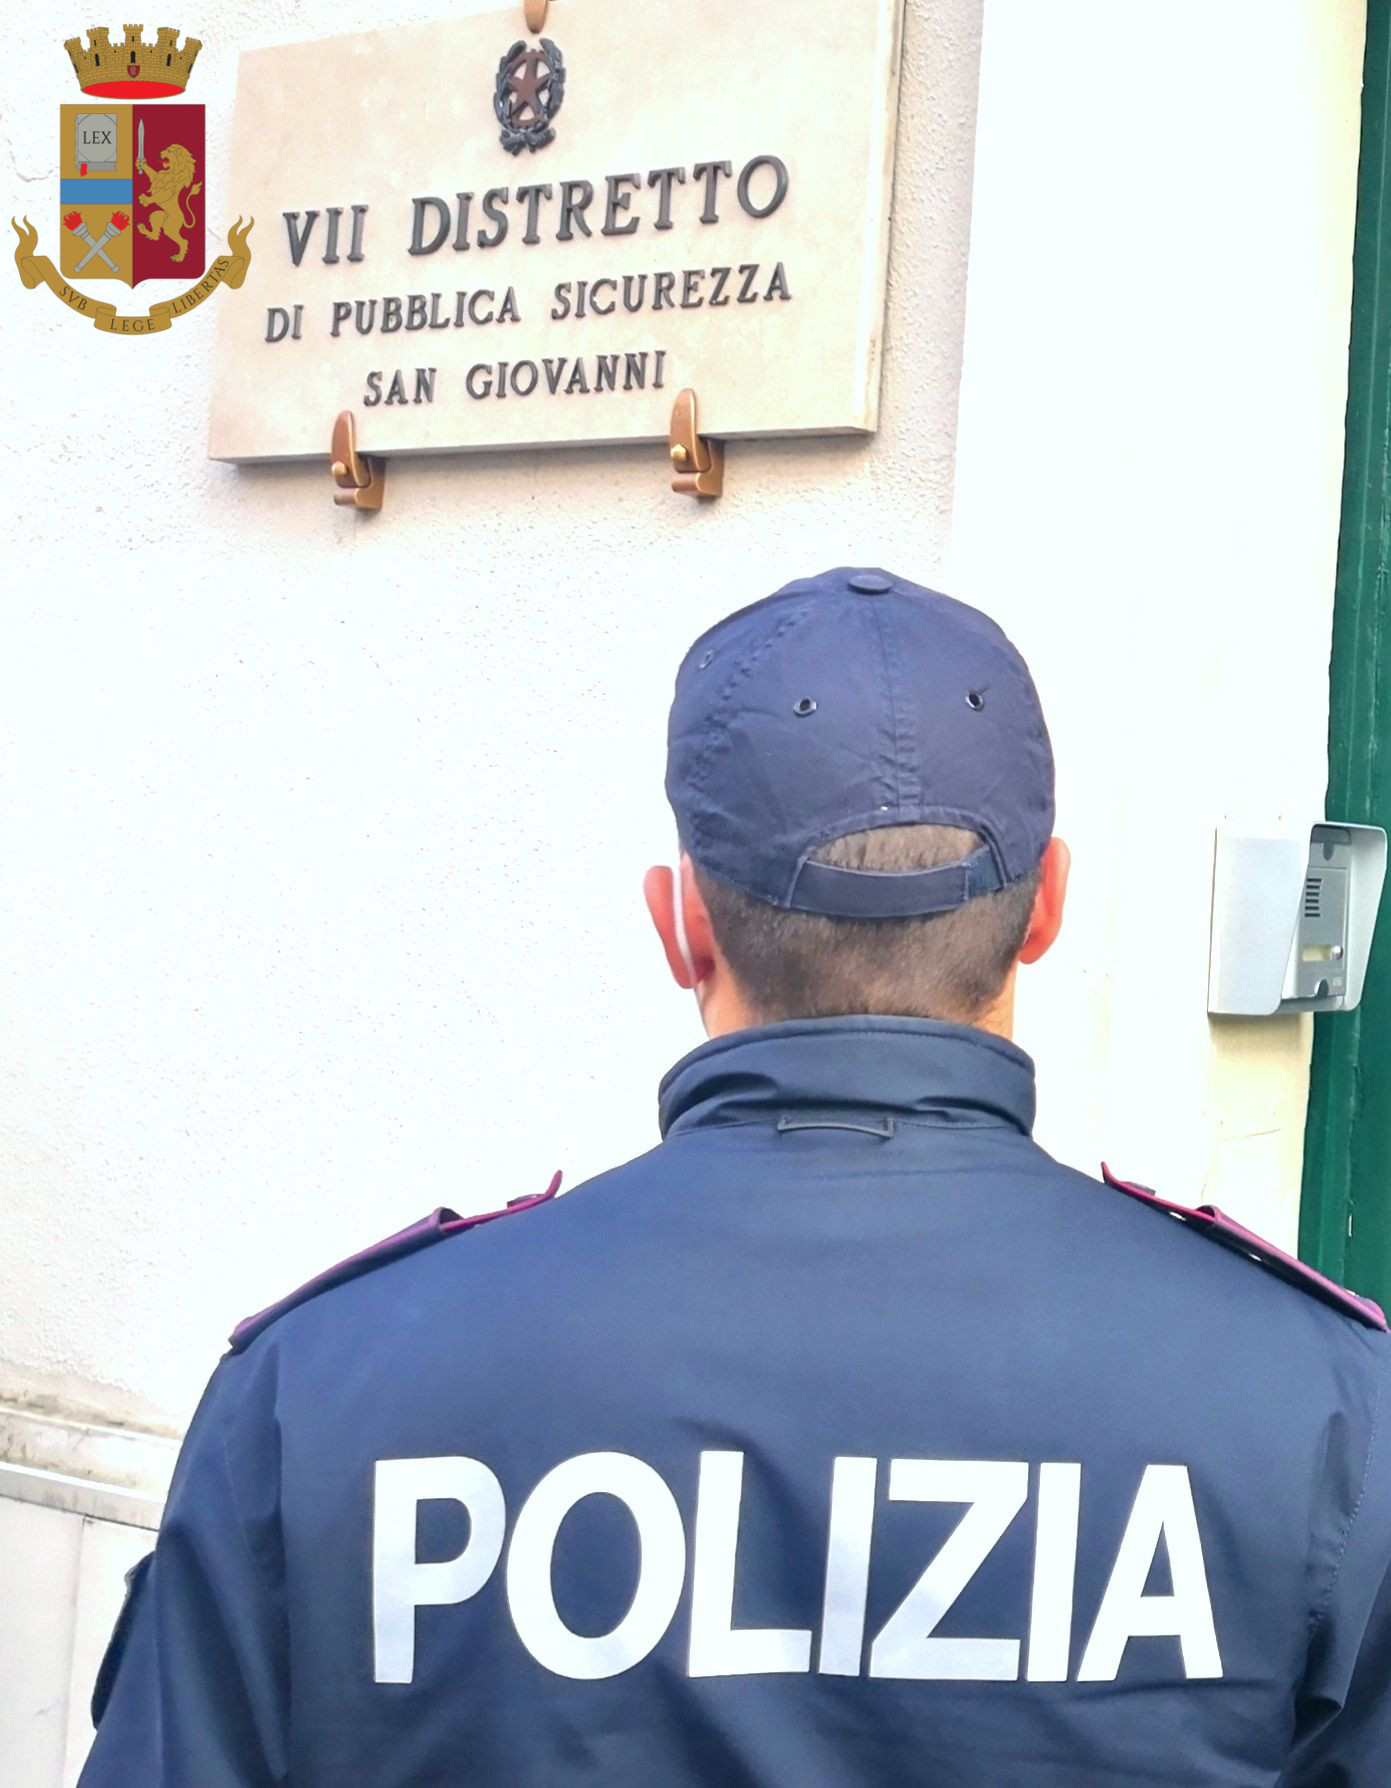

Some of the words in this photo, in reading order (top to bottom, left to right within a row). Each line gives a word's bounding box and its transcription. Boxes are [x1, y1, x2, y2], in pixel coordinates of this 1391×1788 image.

[282, 205, 368, 267] VII
[408, 154, 790, 257] DISTRETTO
[265, 304, 304, 343] DI
[330, 286, 521, 338] PUBBLICA
[551, 261, 792, 321] SICUREZZA
[363, 367, 437, 407] SAN
[465, 350, 667, 400] GIOVANNI
[372, 1450, 1224, 1684] POLIZIA
